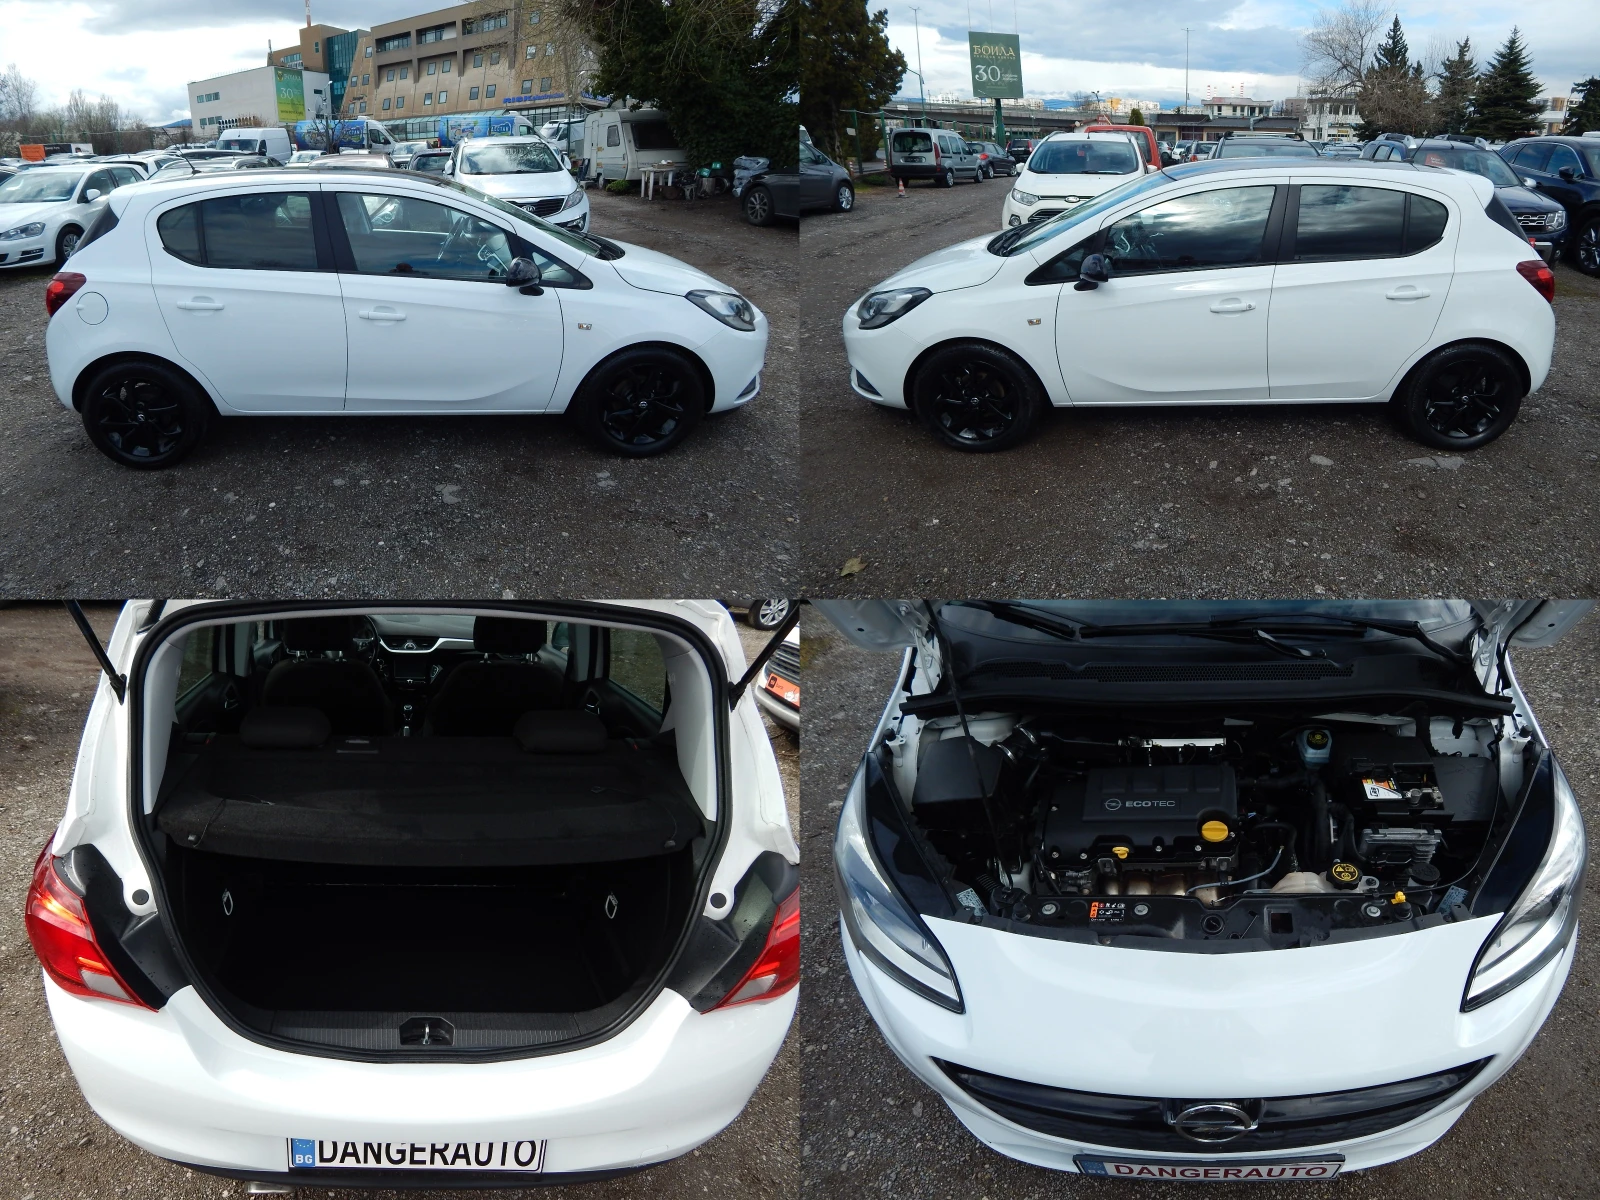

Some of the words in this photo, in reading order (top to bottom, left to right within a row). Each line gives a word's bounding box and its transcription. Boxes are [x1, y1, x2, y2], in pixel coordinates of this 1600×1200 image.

[975, 64, 1001, 81] 30
[280, 87, 294, 100] 30
[1125, 800, 1176, 808] ECOTEC
[295, 1154, 313, 1165] BG
[318, 1139, 536, 1167] DANGERAUTO
[1114, 1163, 1328, 1179] DANGERAUTO
